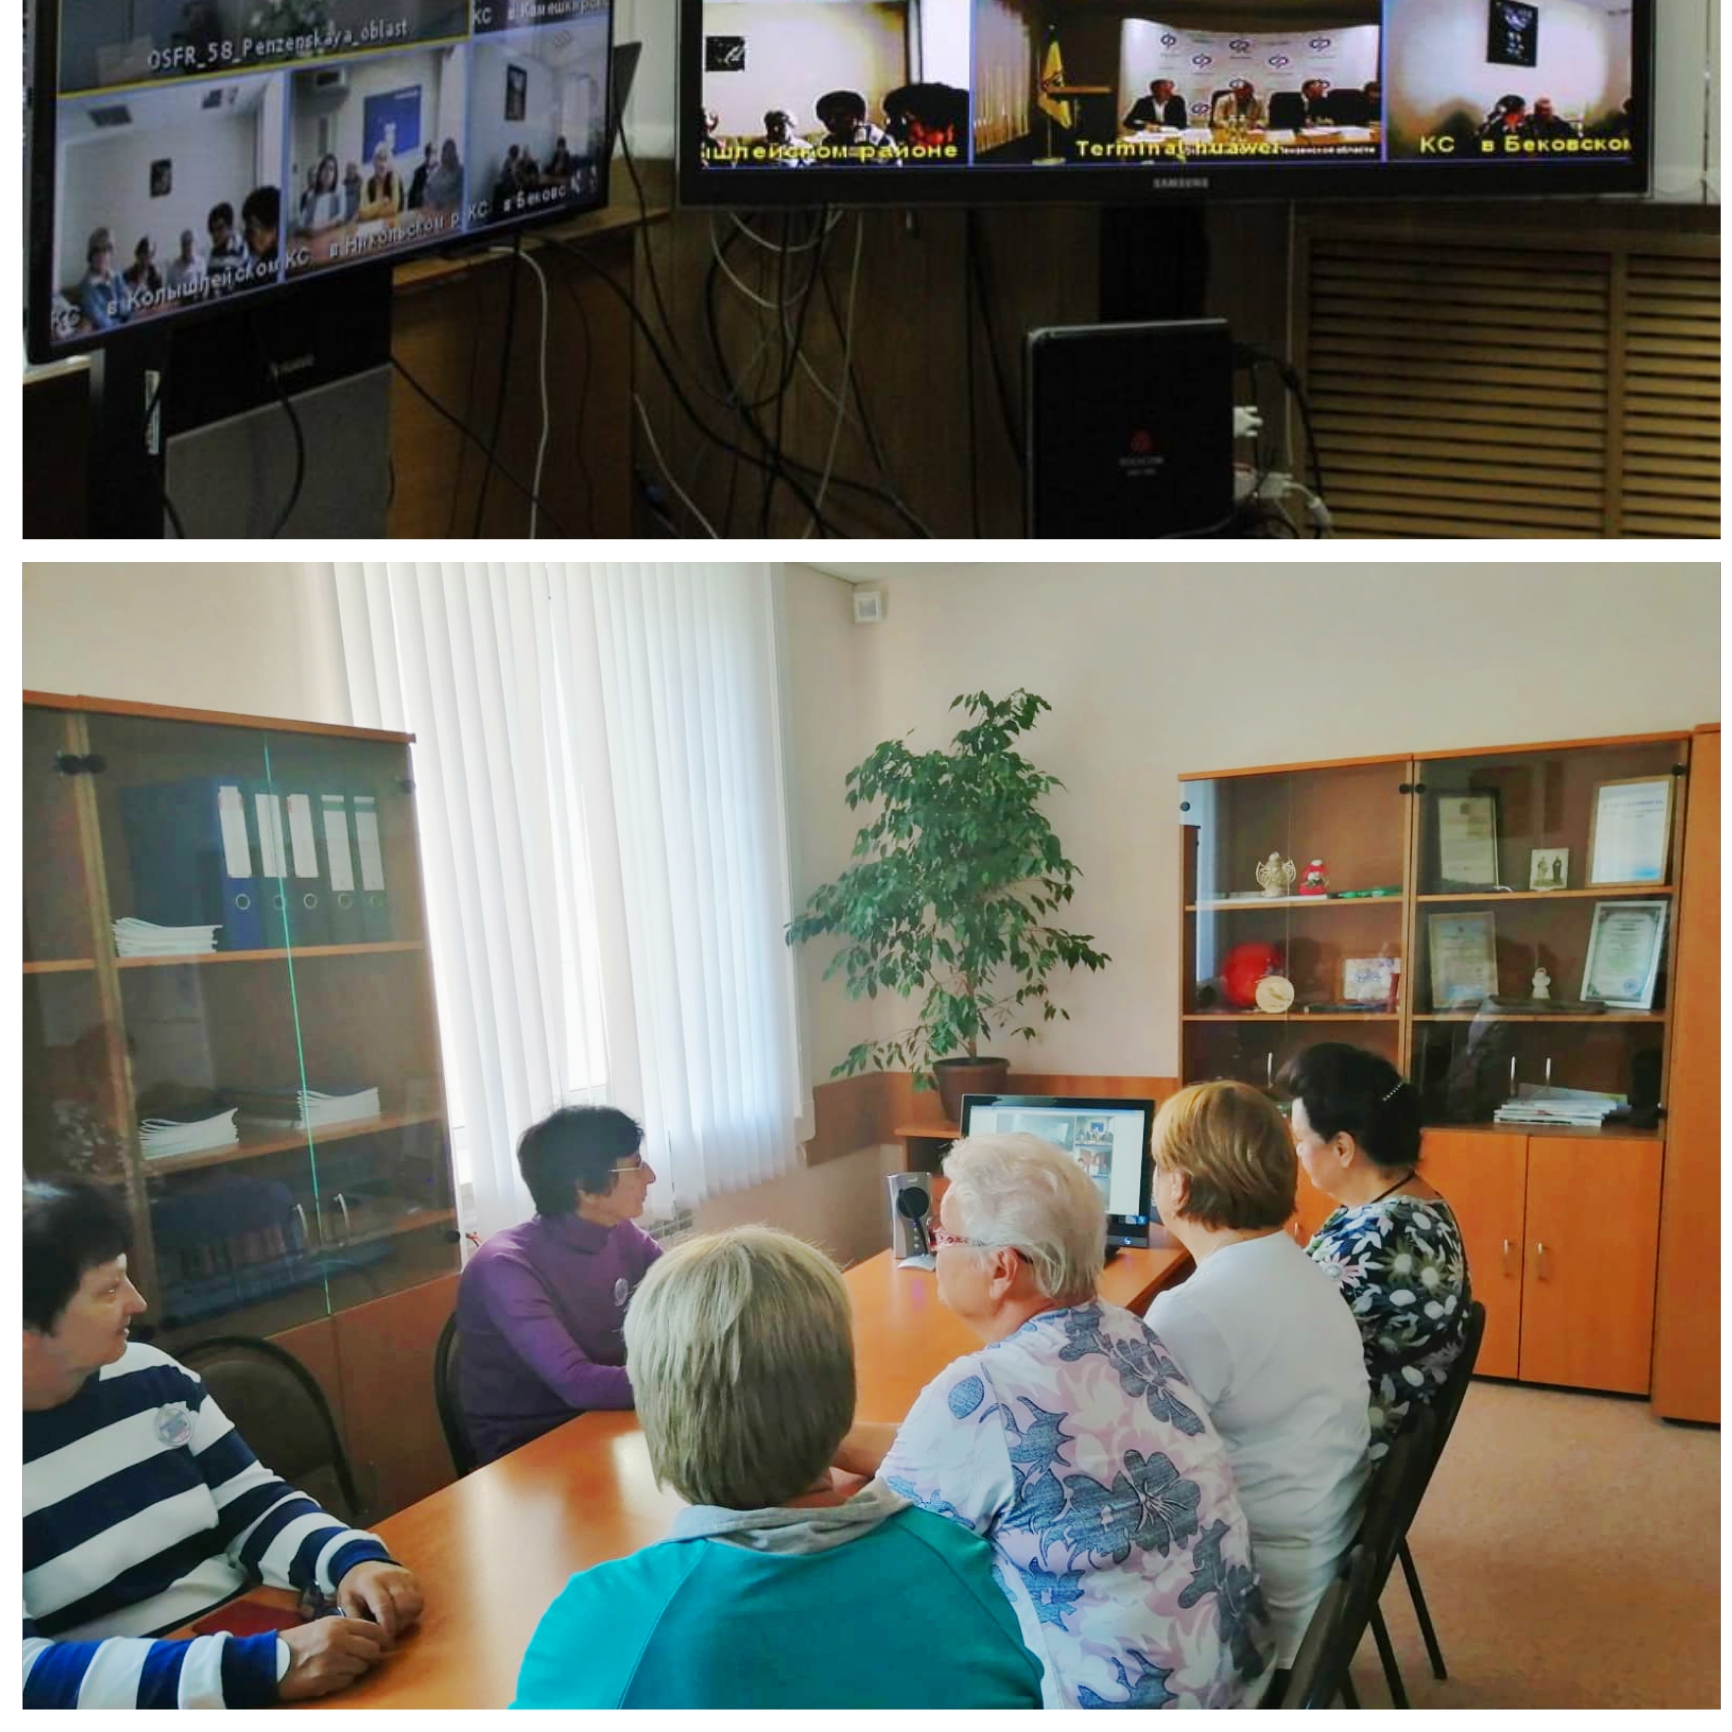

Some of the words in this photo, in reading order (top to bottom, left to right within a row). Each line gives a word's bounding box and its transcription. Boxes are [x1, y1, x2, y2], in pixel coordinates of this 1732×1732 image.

[860, 143, 958, 161] районе
[1420, 137, 1455, 153] КС
[1481, 140, 1495, 152] в
[1153, 178, 1209, 189] SAMSUNG
